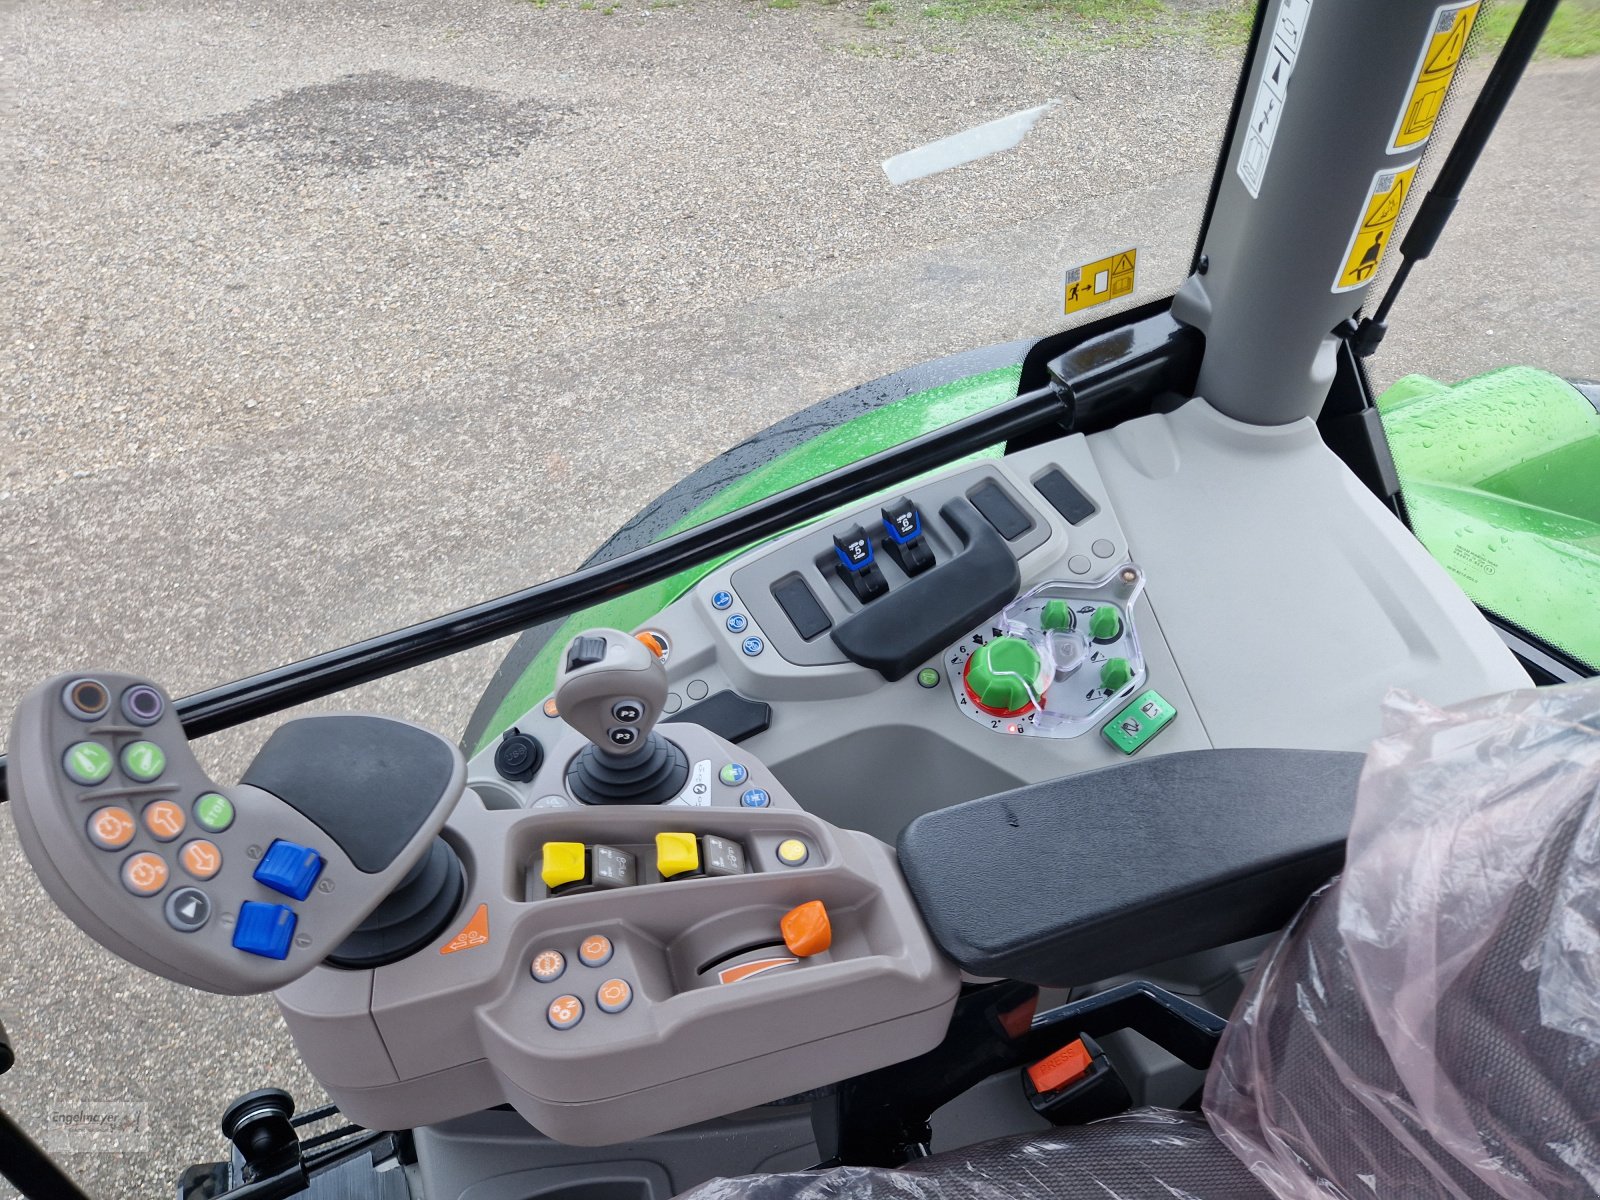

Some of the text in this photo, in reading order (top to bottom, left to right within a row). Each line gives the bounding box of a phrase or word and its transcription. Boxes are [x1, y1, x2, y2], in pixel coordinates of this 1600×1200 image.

[902, 517, 910, 527] 6
[854, 545, 863, 555] 5
[959, 645, 967, 653] 6
[960, 697, 968, 705] 4
[991, 720, 998, 729] 2
[204, 798, 227, 825] STOP
[1039, 1048, 1074, 1075] PRESS
